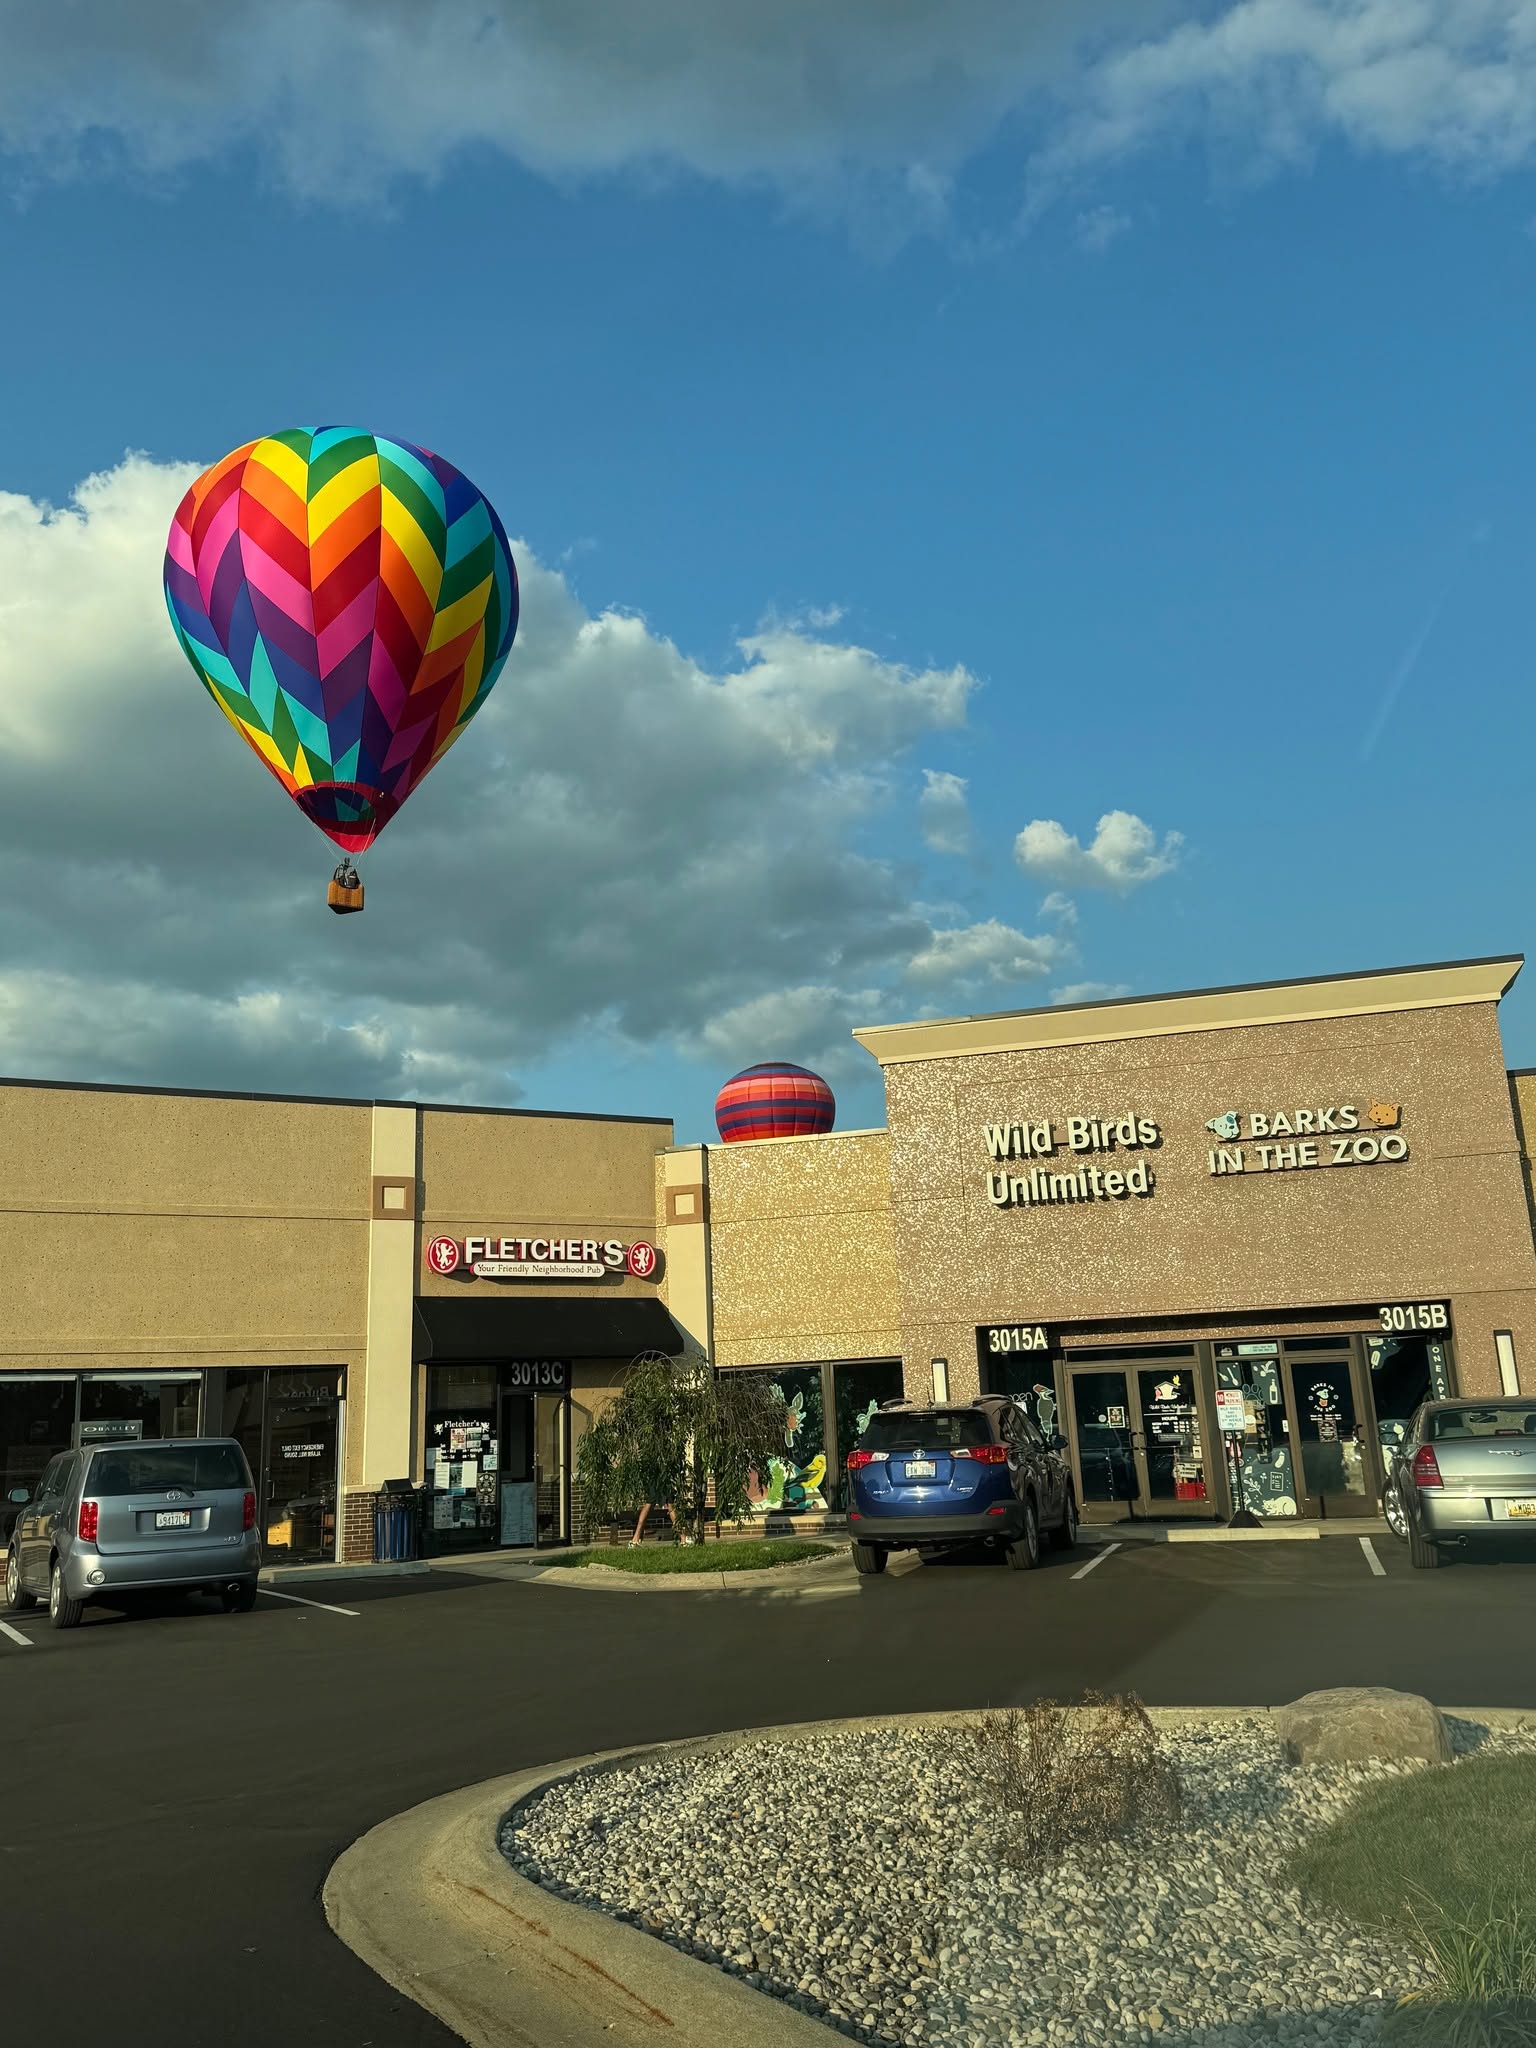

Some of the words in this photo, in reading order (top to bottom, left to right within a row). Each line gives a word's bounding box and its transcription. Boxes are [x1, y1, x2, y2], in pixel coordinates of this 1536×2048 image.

[983, 1119, 1053, 1157] Wild
[1066, 1111, 1158, 1150] Birds
[1250, 1105, 1358, 1137] BARKS
[1208, 1147, 1245, 1174] IN
[1255, 1141, 1320, 1170] THE
[1330, 1134, 1408, 1164] ZOO
[986, 1159, 1149, 1204] Unlimited
[464, 1236, 624, 1266] FLETCHER'S
[477, 1264, 496, 1274] Your
[497, 1264, 531, 1275] Friendly
[532, 1264, 586, 1276] Neighborhood
[587, 1265, 602, 1275] Pub
[1379, 1304, 1448, 1331] 3015B
[988, 1326, 1049, 1352] 3015A
[511, 1361, 563, 1385] 3013C
[1432, 1346, 1442, 1373] ONE
[444, 1419, 480, 1428] Fletcher's
